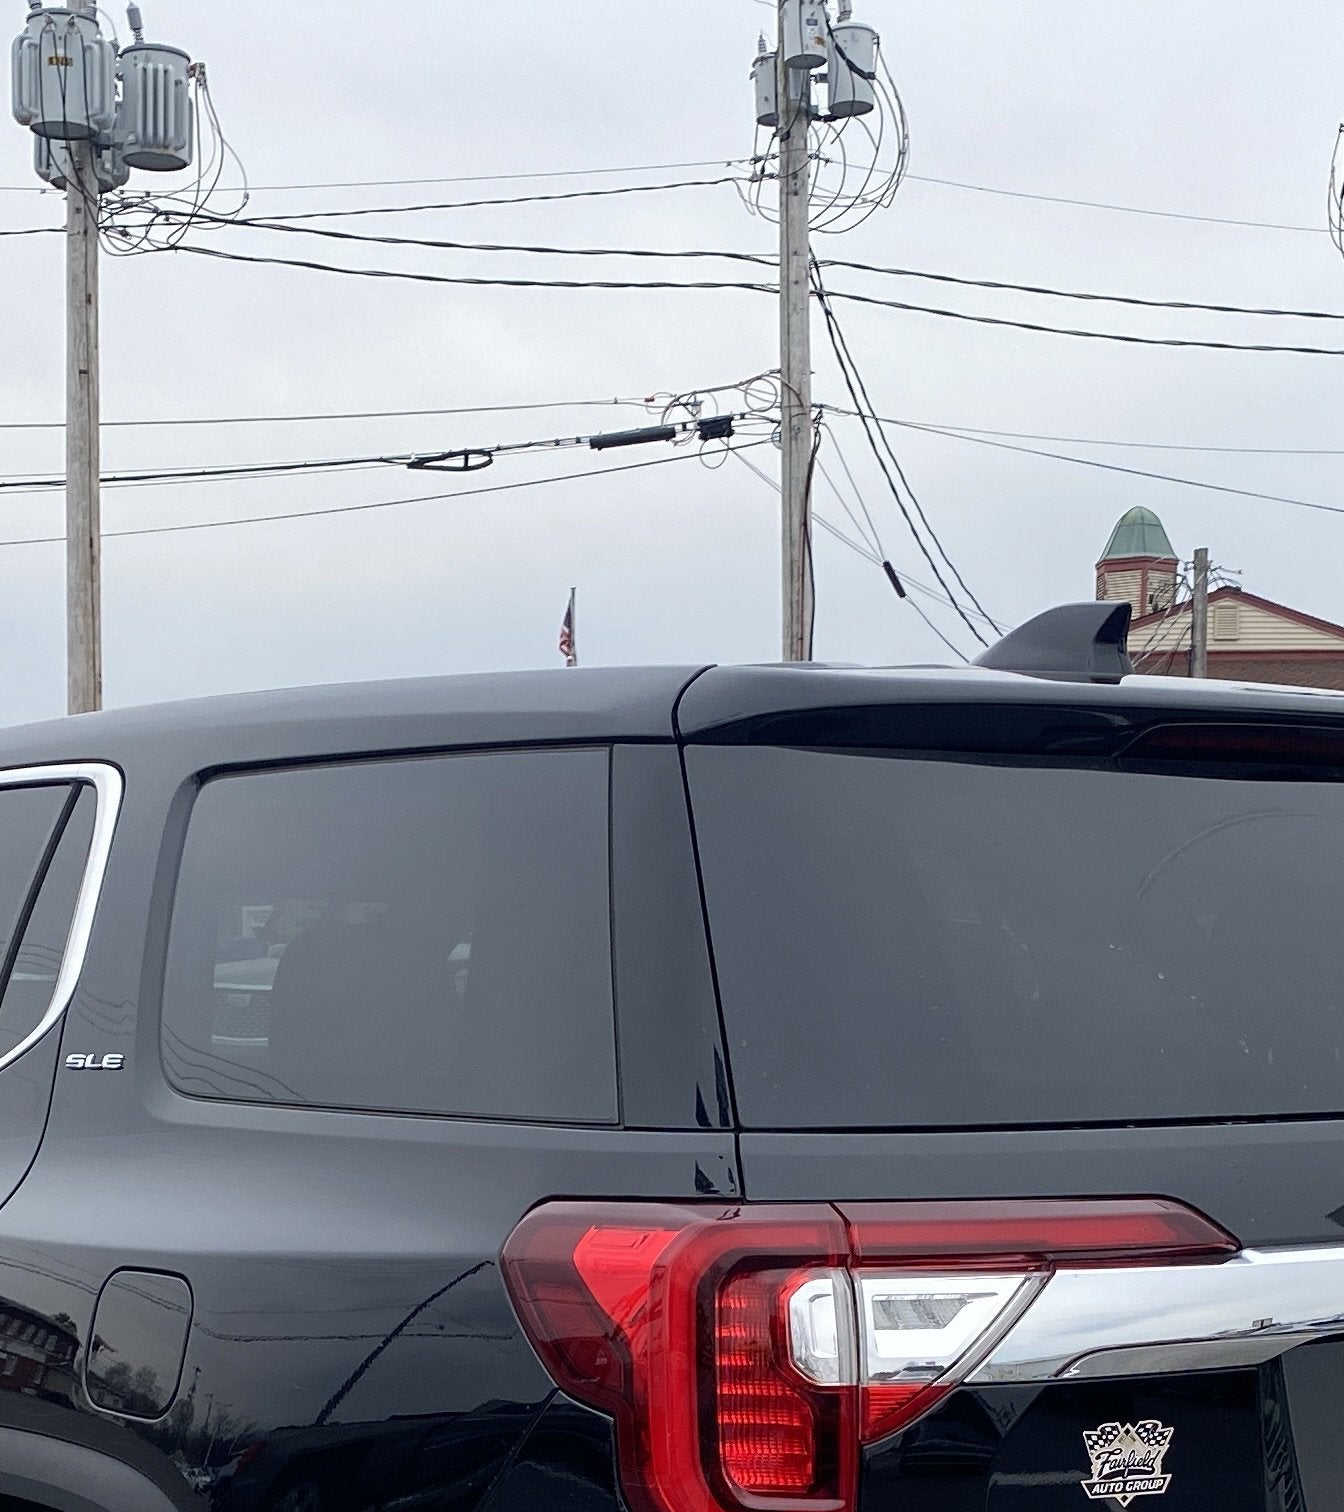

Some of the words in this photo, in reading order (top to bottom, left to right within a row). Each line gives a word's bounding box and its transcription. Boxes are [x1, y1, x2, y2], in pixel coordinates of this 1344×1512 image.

[64, 1053, 125, 1071] SLE
[1094, 1448, 1162, 1480] Fairfield
[1091, 1482, 1123, 1495] AUTO
[1125, 1479, 1164, 1492] GROUP
